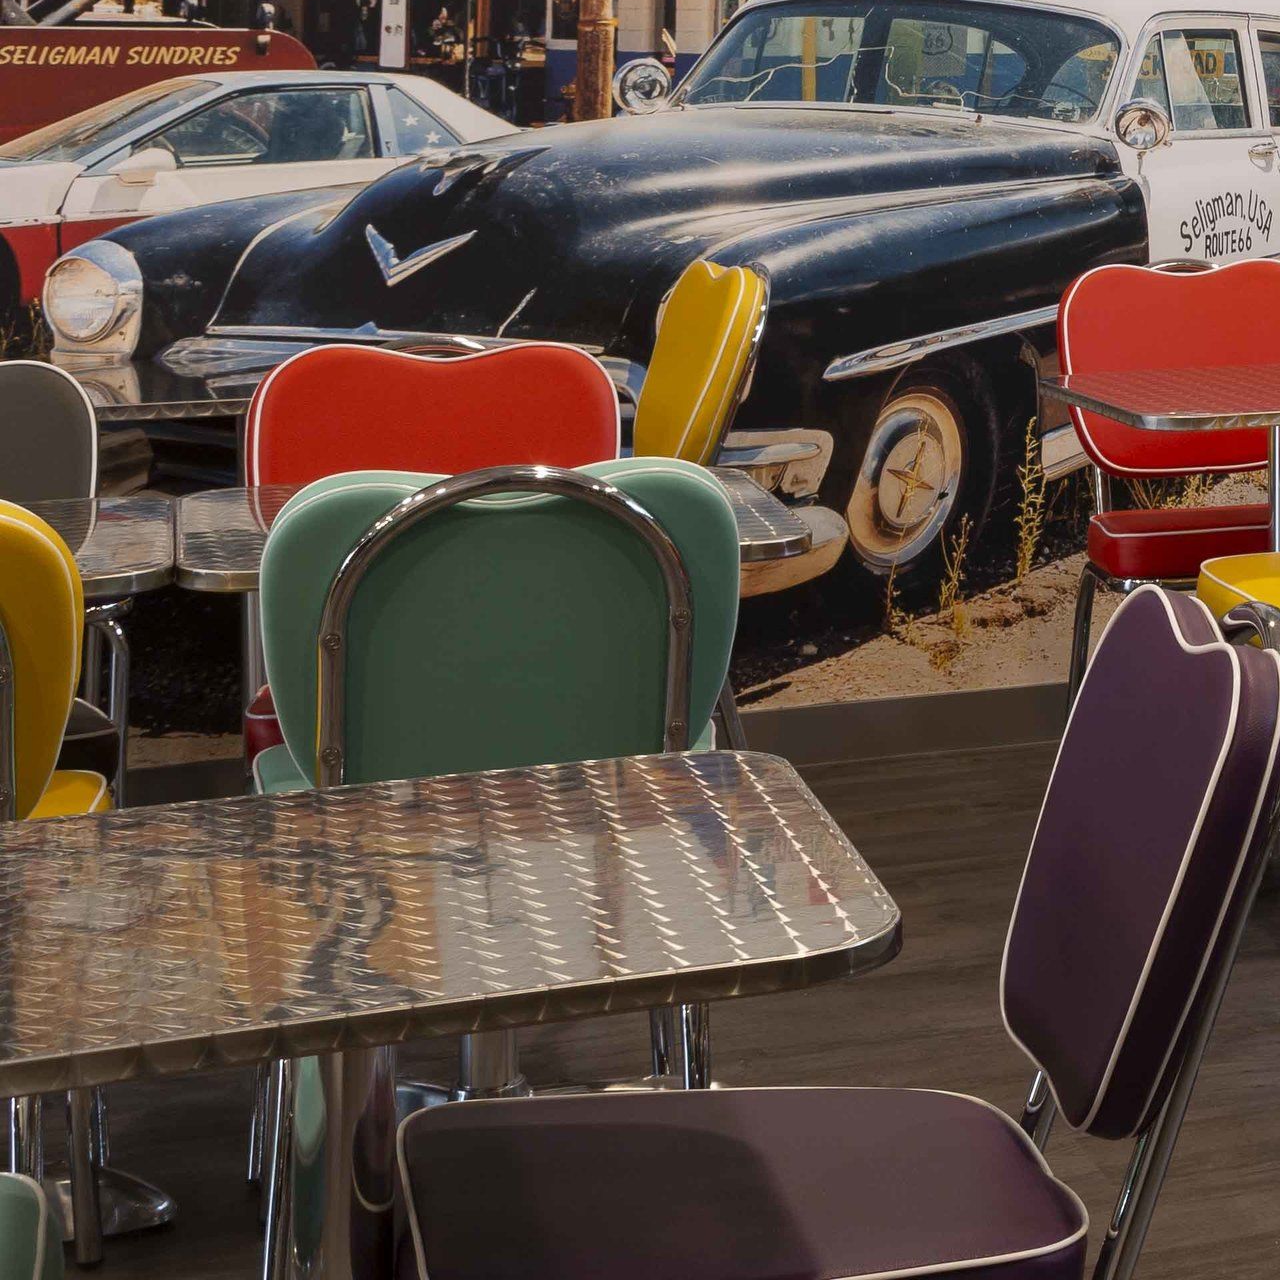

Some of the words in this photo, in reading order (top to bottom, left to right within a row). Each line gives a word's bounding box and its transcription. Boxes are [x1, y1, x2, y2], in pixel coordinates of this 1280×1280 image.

[0, 45, 120, 65] SELIGMAN
[126, 45, 241, 66] SUNDRIES
[1247, 189, 1273, 243] USA
